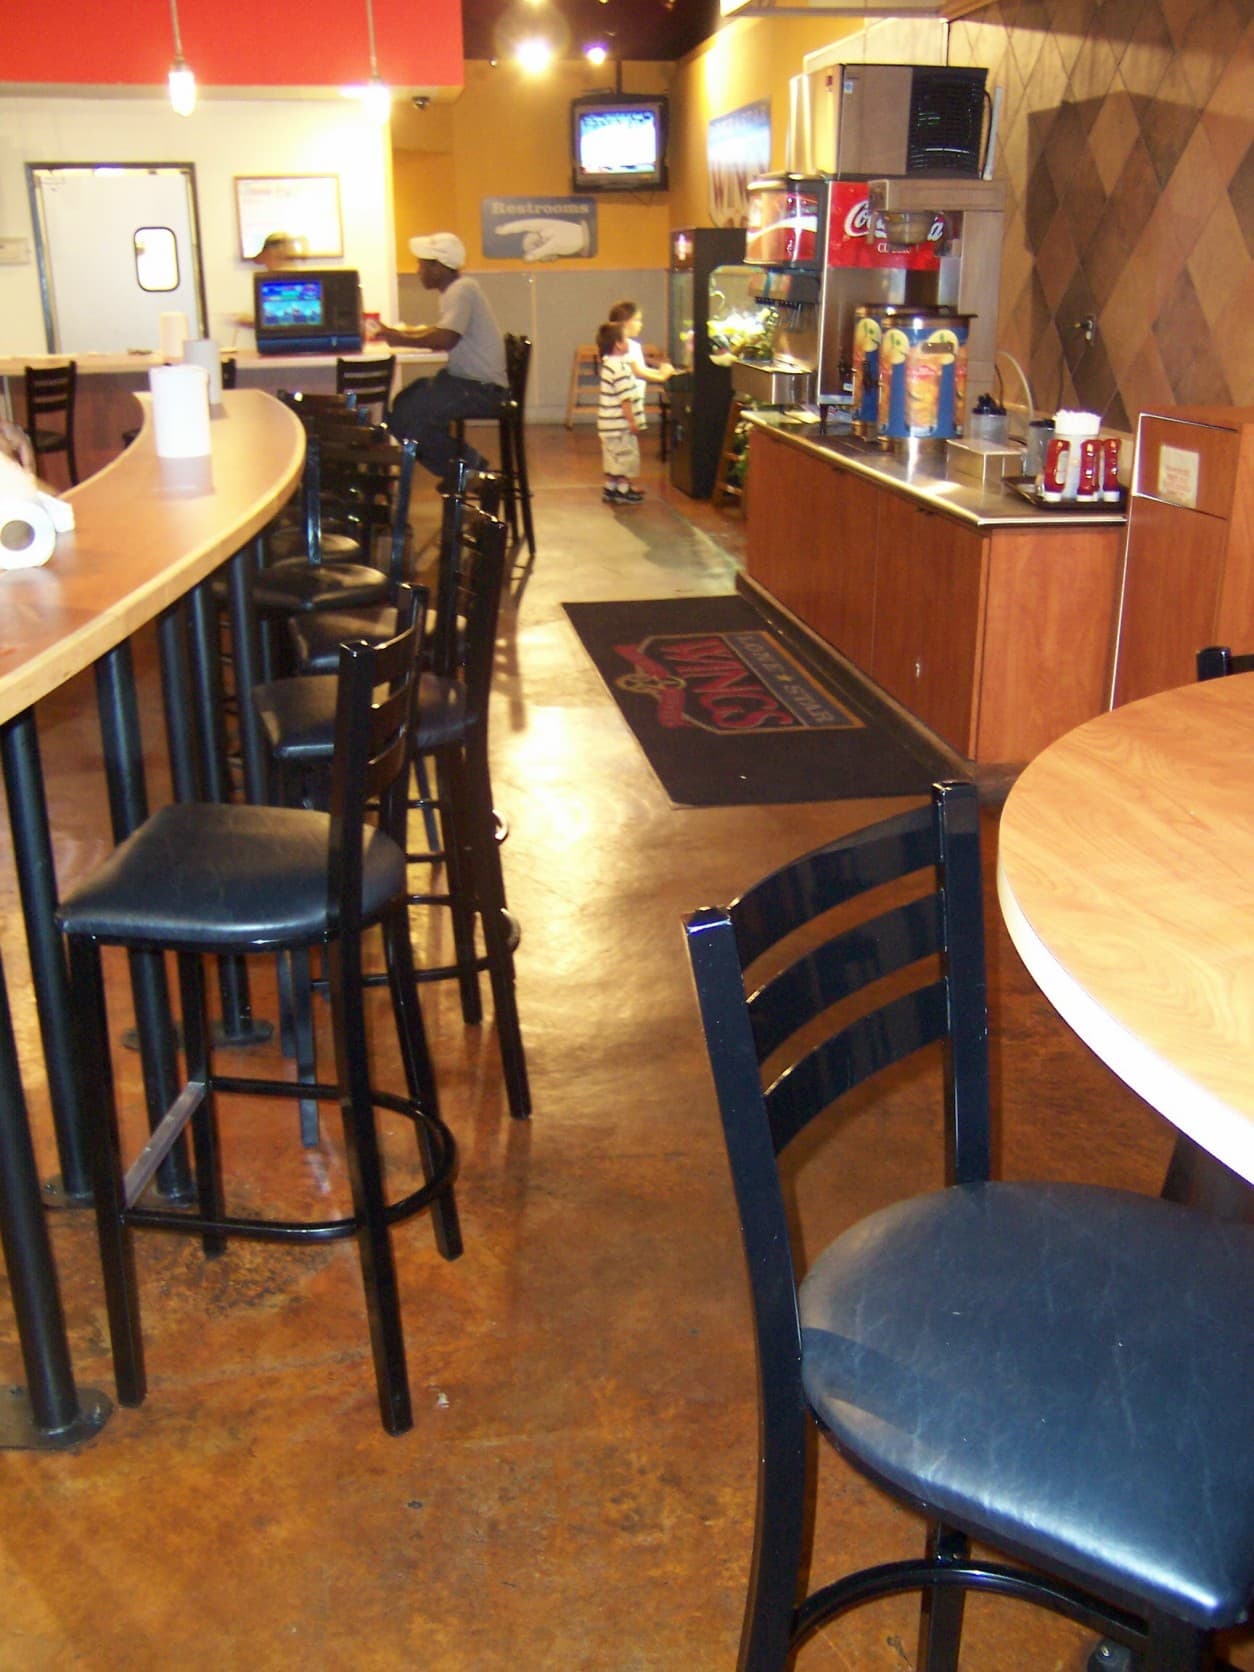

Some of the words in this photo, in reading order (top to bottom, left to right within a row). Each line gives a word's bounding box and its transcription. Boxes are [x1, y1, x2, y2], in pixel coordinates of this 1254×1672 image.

[491, 202, 589, 215] Restrooms
[660, 638, 793, 729] WINGS
[736, 635, 785, 672] LONE
[783, 685, 835, 722] STAR
